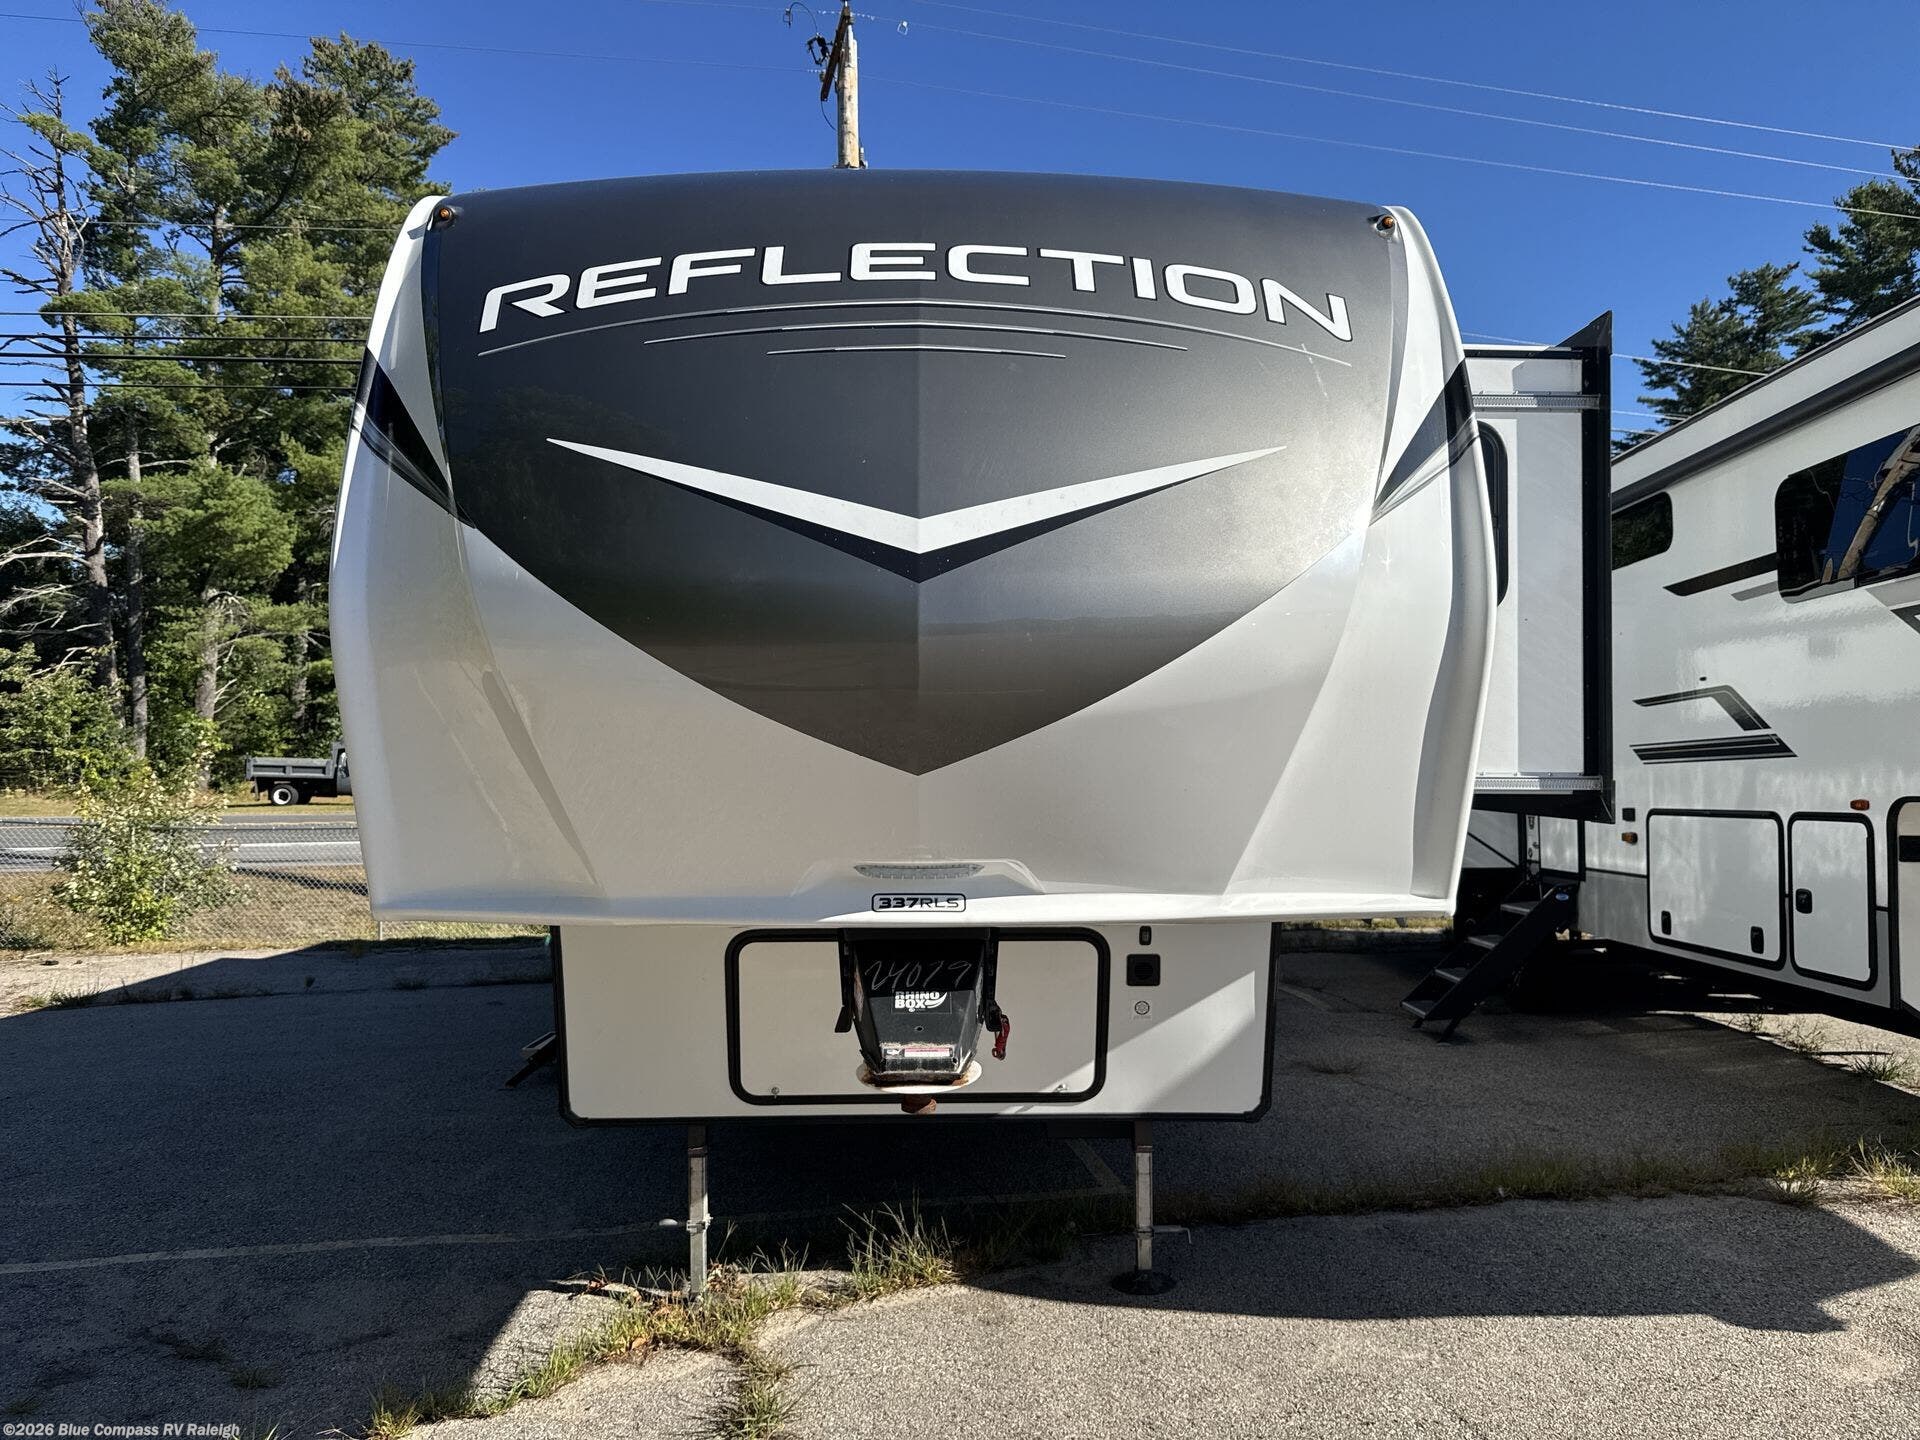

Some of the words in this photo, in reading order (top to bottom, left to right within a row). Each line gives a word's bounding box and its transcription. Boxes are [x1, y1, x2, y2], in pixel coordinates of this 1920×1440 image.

[478, 241, 1354, 343] REFLECTION
[878, 897, 959, 909] 337RLS
[895, 991, 940, 1000] RHINO
[894, 1000, 926, 1009] BOX
